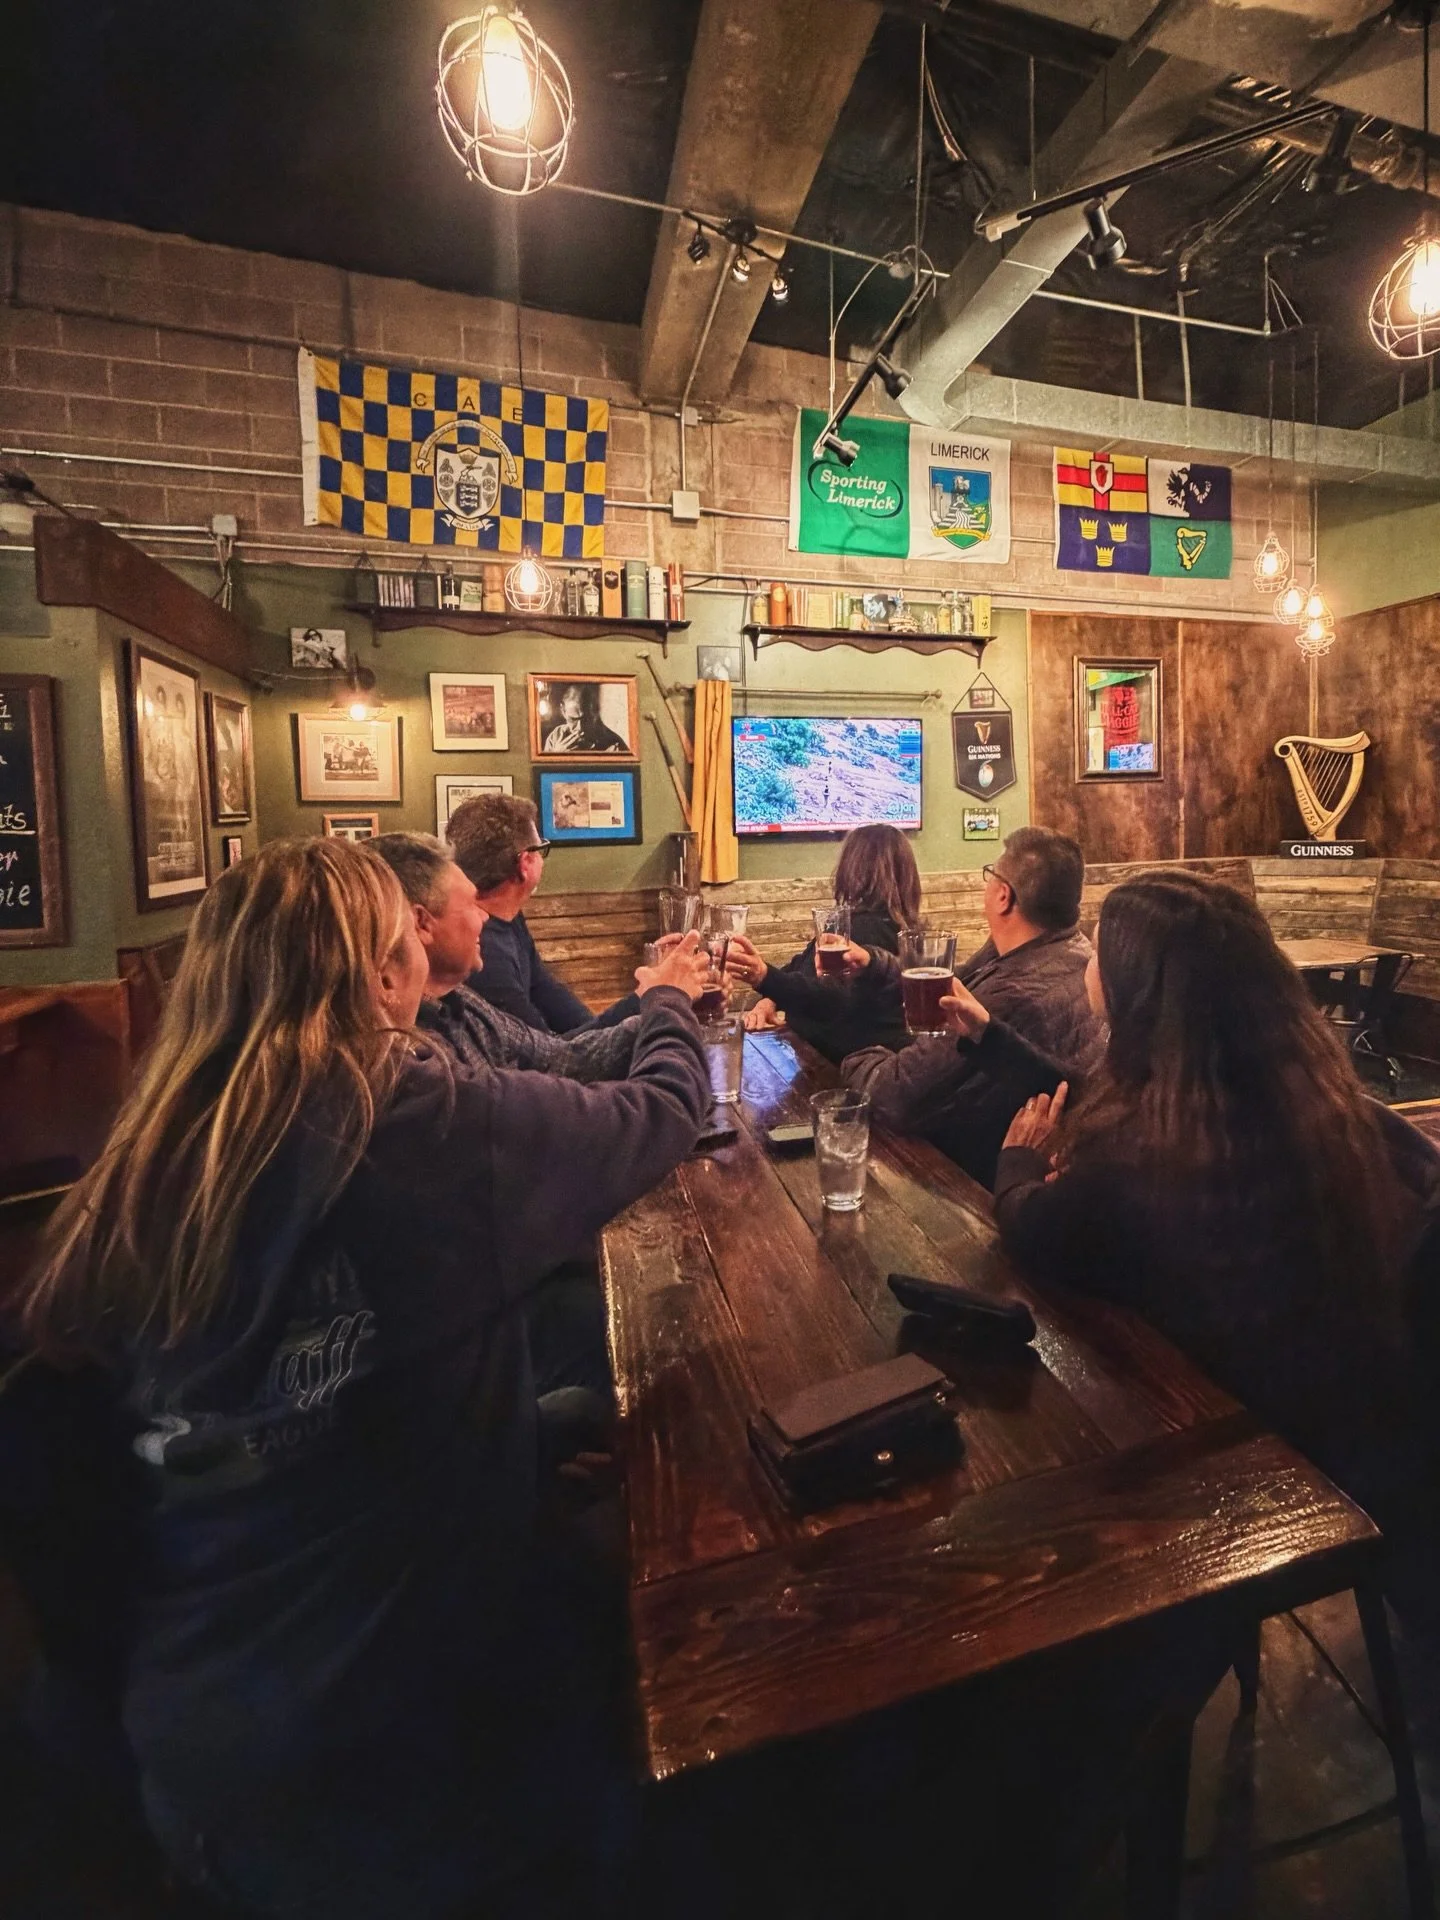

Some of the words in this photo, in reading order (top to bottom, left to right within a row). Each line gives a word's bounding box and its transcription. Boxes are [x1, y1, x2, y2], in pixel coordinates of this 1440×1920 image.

[930, 442, 990, 462] LIMERICK
[820, 469, 887, 494] Sporting
[826, 489, 896, 511] Limerick
[967, 744, 1001, 754] GUINNESS
[978, 752, 1001, 760] NATIONS
[1302, 805, 1318, 827] 1759
[1290, 844, 1354, 857] GUINNESS
